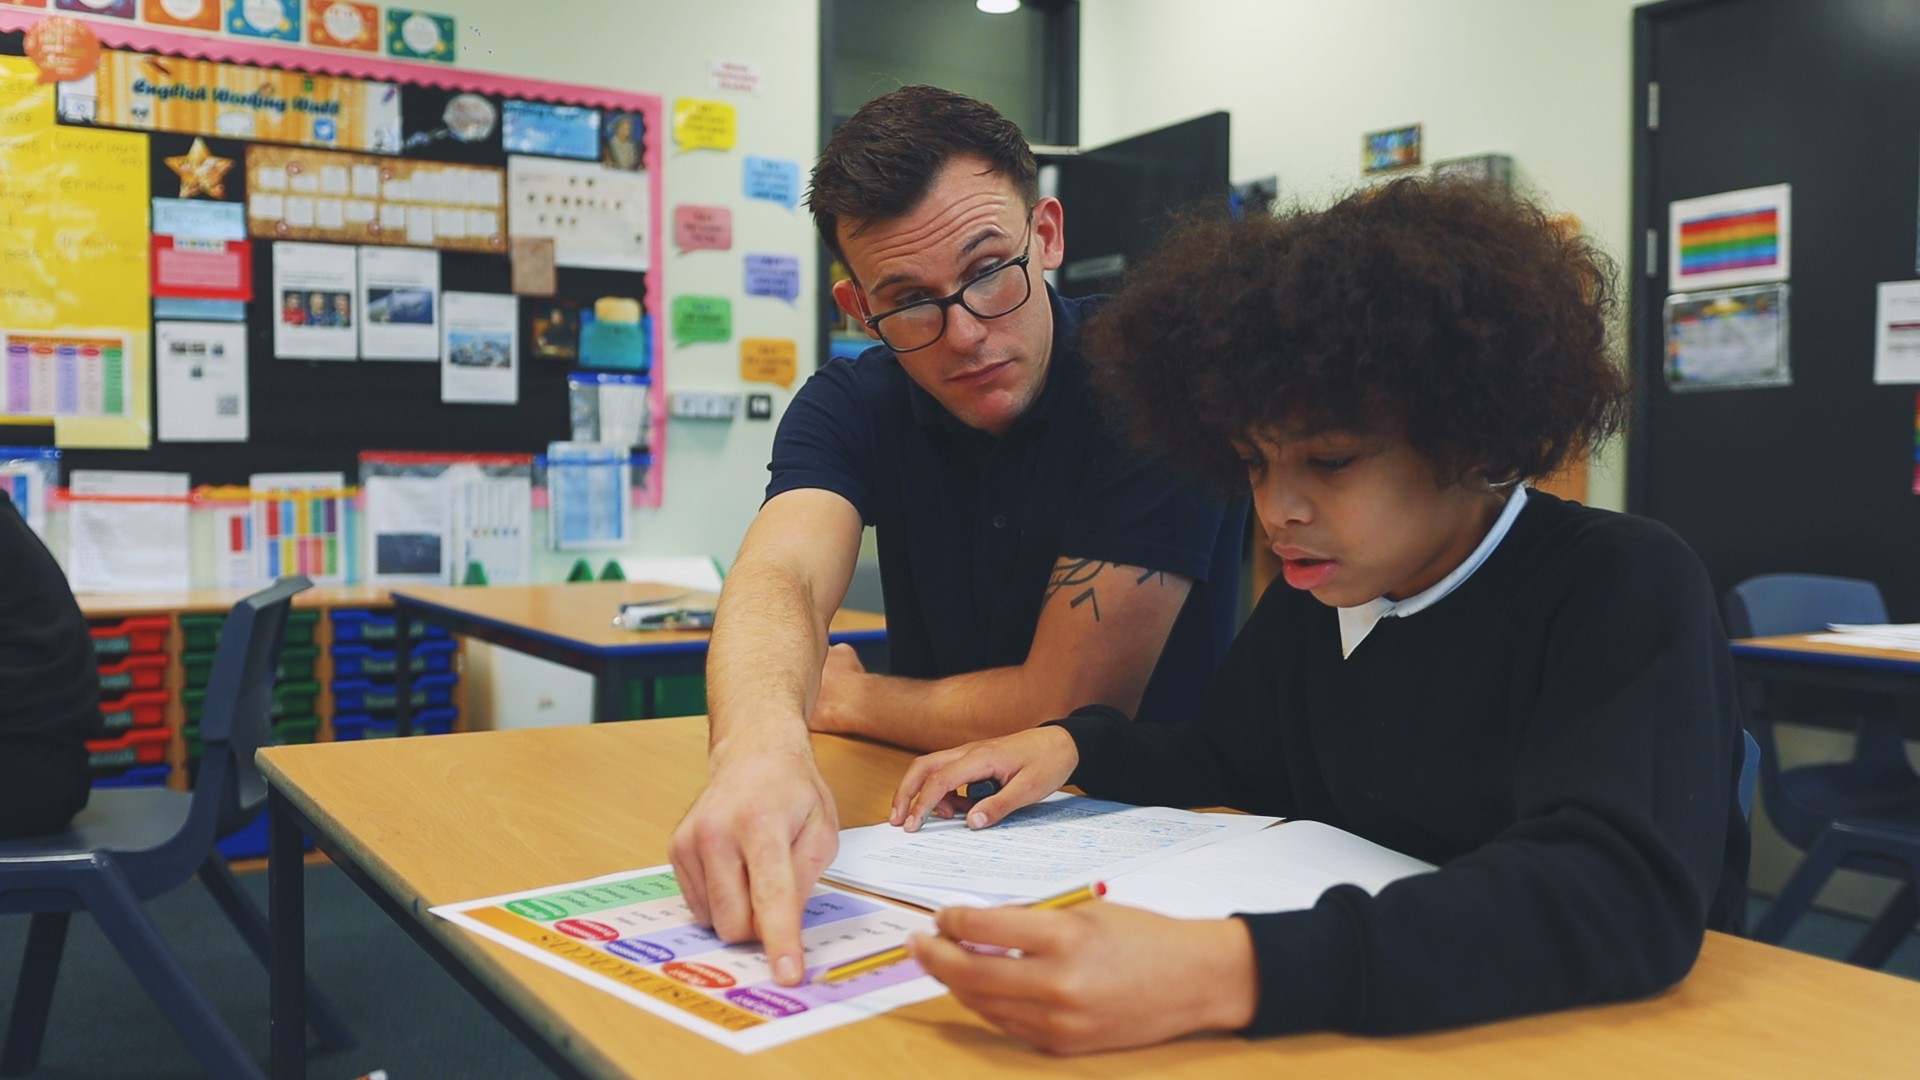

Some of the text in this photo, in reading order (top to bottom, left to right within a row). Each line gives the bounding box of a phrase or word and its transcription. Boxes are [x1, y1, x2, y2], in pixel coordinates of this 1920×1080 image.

[133, 78, 339, 115] English Working Wall
